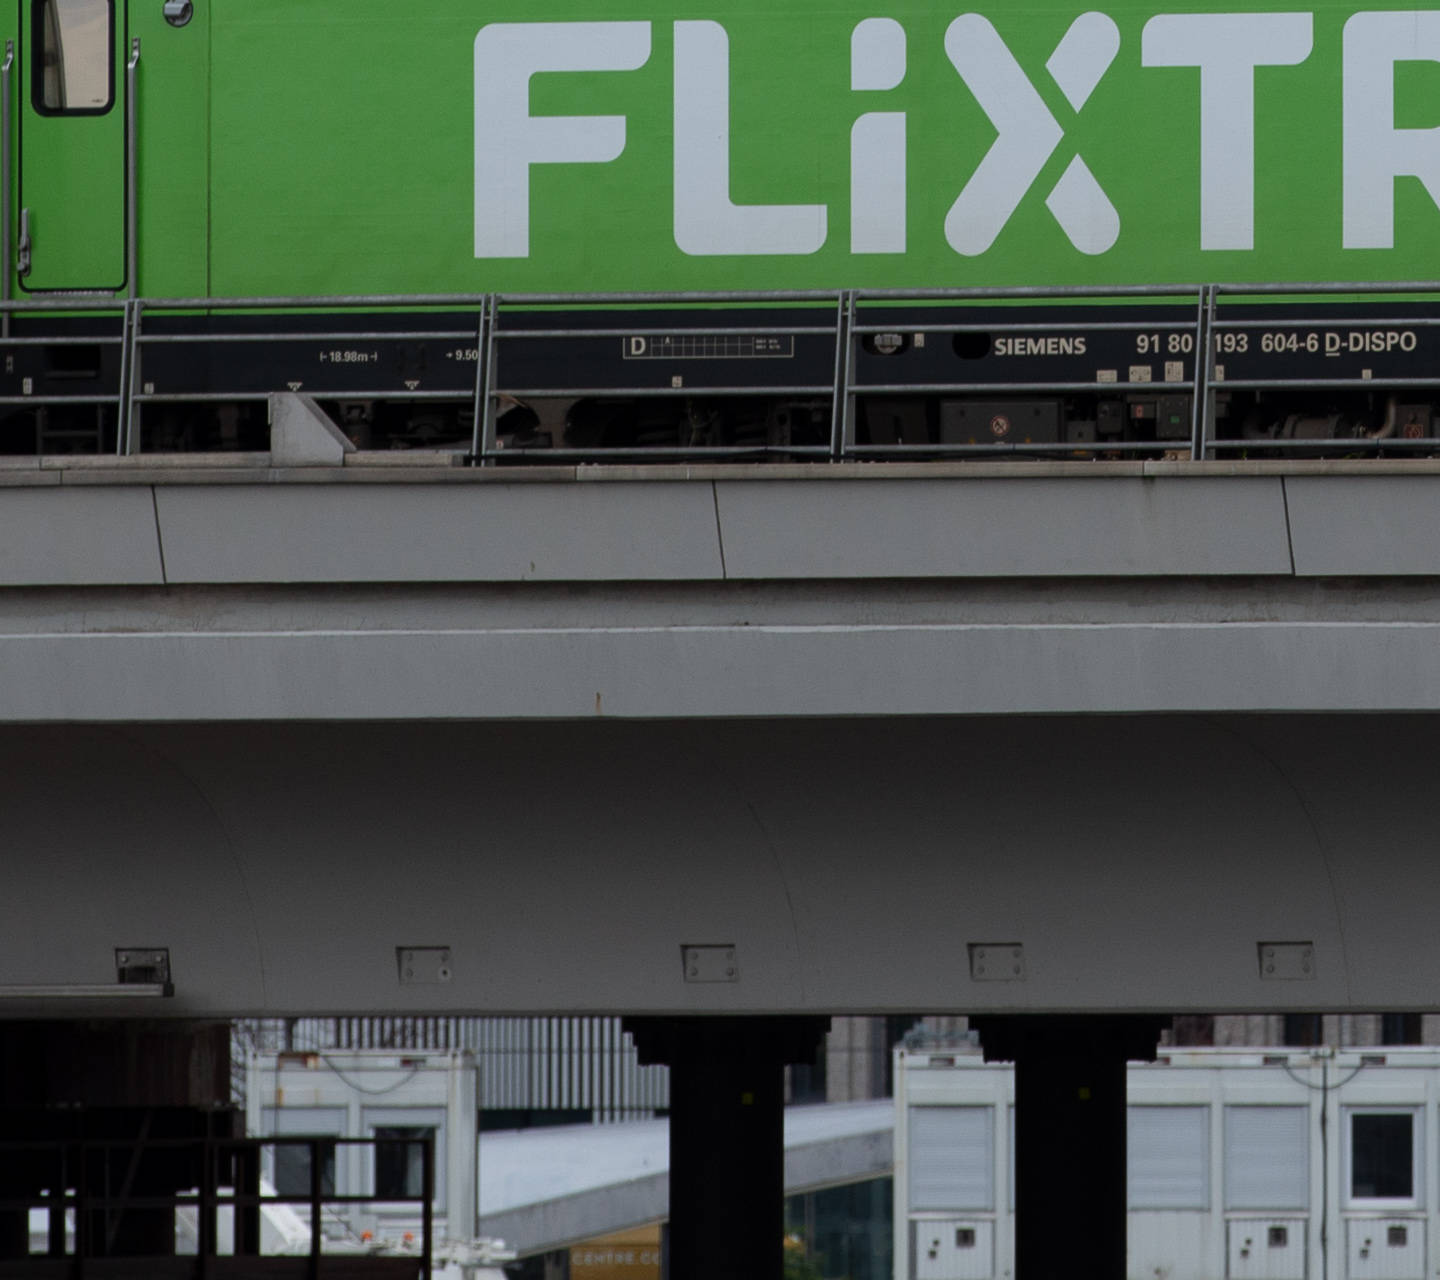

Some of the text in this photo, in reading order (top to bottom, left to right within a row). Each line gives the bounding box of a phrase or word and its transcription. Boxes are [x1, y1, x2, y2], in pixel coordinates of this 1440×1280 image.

[631, 336, 647, 356] D
[994, 336, 1087, 356] SIEMENS
[1136, 334, 1160, 354] 91
[1168, 333, 1193, 353] 80
[1261, 332, 1319, 353] 604-6
[1325, 331, 1417, 357] D-DISPO
